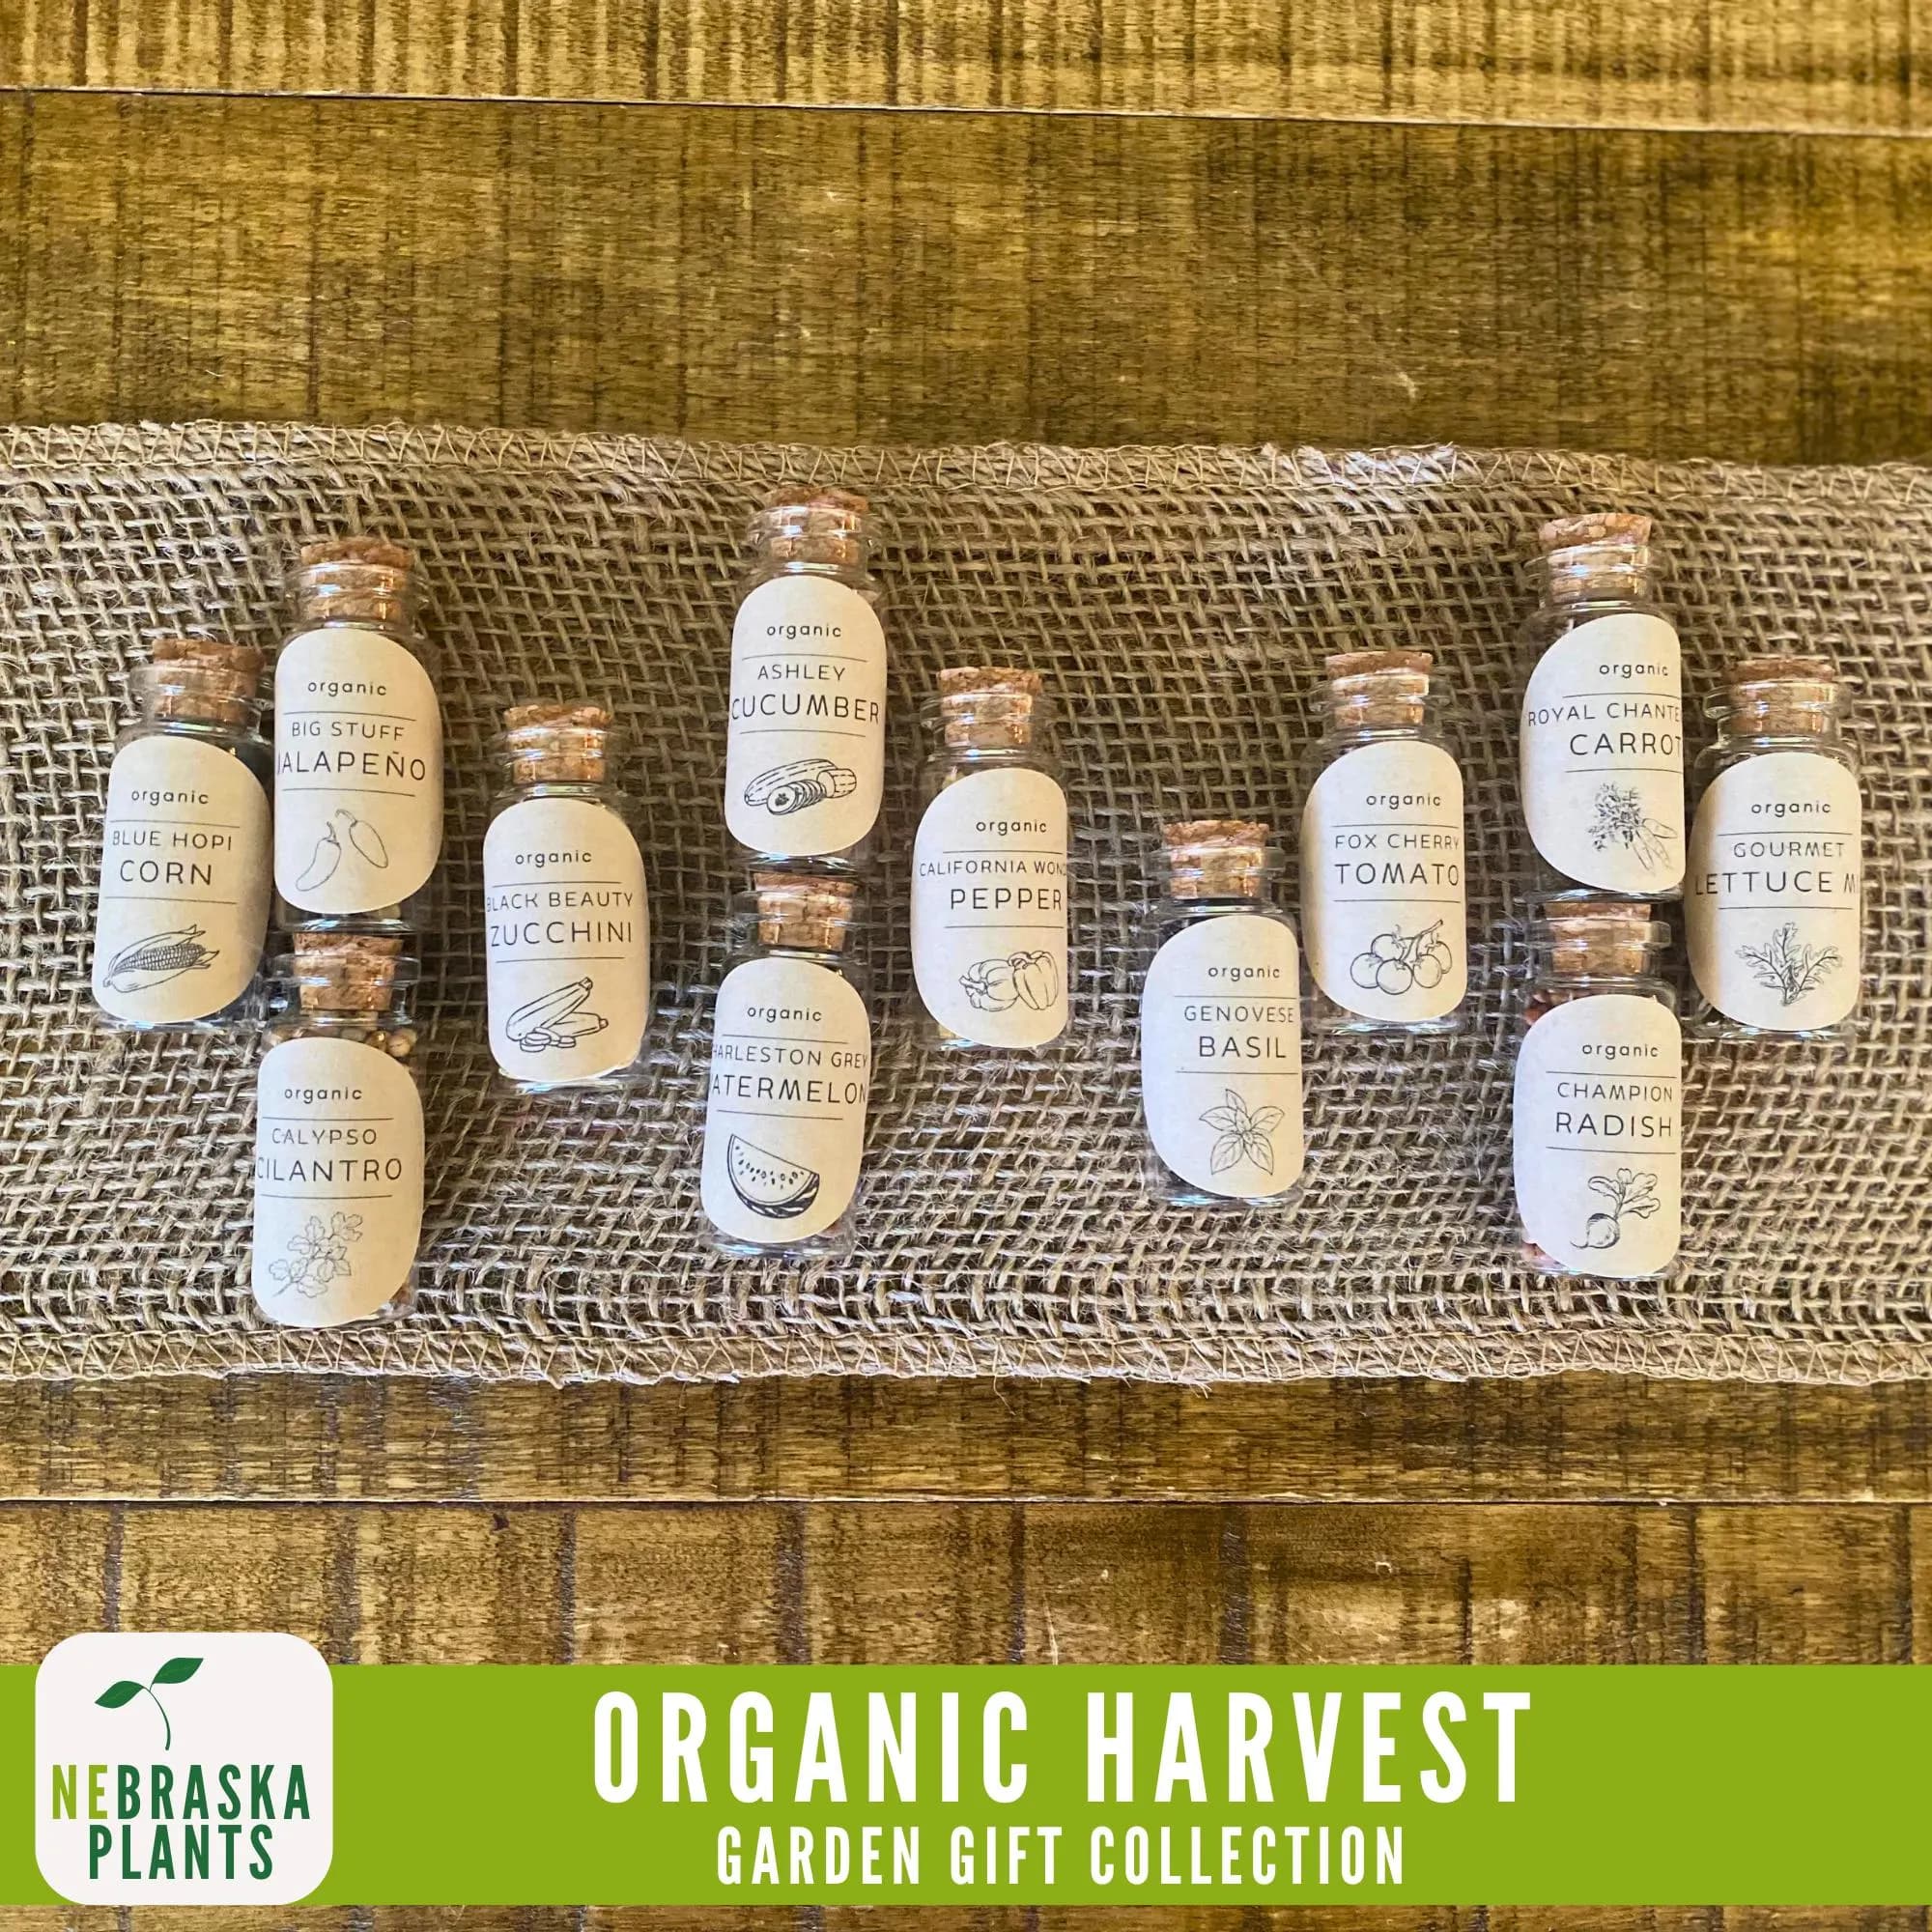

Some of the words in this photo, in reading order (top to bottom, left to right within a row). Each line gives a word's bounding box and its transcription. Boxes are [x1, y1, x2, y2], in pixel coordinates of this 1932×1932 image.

[766, 623, 841, 640] organic
[757, 664, 846, 681] ASHLEY
[1599, 662, 1668, 679] organic
[307, 679, 387, 696] organic
[732, 694, 879, 724] CUCUMBER
[1528, 704, 1596, 727] ROYAL
[292, 721, 321, 737] BIG
[331, 722, 406, 741] STUFF
[1570, 732, 1681, 758] CARROT
[131, 789, 209, 806] organic
[1366, 792, 1441, 810] organic
[1751, 800, 1831, 818] organic
[976, 819, 1047, 837] organic
[112, 830, 161, 847] BLUE
[173, 832, 233, 851] HOPI
[1335, 834, 1377, 849] FOX
[1387, 833, 1459, 850] CHERRY
[1733, 841, 1845, 858] GOURMET
[515, 849, 592, 868] organic
[120, 860, 213, 886] CORN
[920, 860, 1027, 877] CALIFORNIA
[1334, 862, 1459, 886] TOMATO
[1694, 870, 1833, 895] LETTUCE
[487, 893, 539, 913] BLACK
[549, 891, 634, 907] BEAUTY
[951, 888, 1062, 911] PEPPER
[491, 921, 632, 947] ZUCCHINI
[1208, 966, 1280, 982] organic
[747, 1007, 822, 1023] organic
[1184, 1006, 1294, 1023] GENOVESE
[1199, 1036, 1286, 1059] BASIL
[1581, 1043, 1659, 1061] organic
[831, 1051, 867, 1068] GREY
[284, 1087, 362, 1104] organic
[711, 1073, 866, 1104] ATERMELON
[1557, 1082, 1672, 1102] CHAMPION
[1555, 1112, 1671, 1138] RADISH
[271, 1128, 377, 1146] CALYPSO
[257, 1157, 402, 1182] CILANTRO
